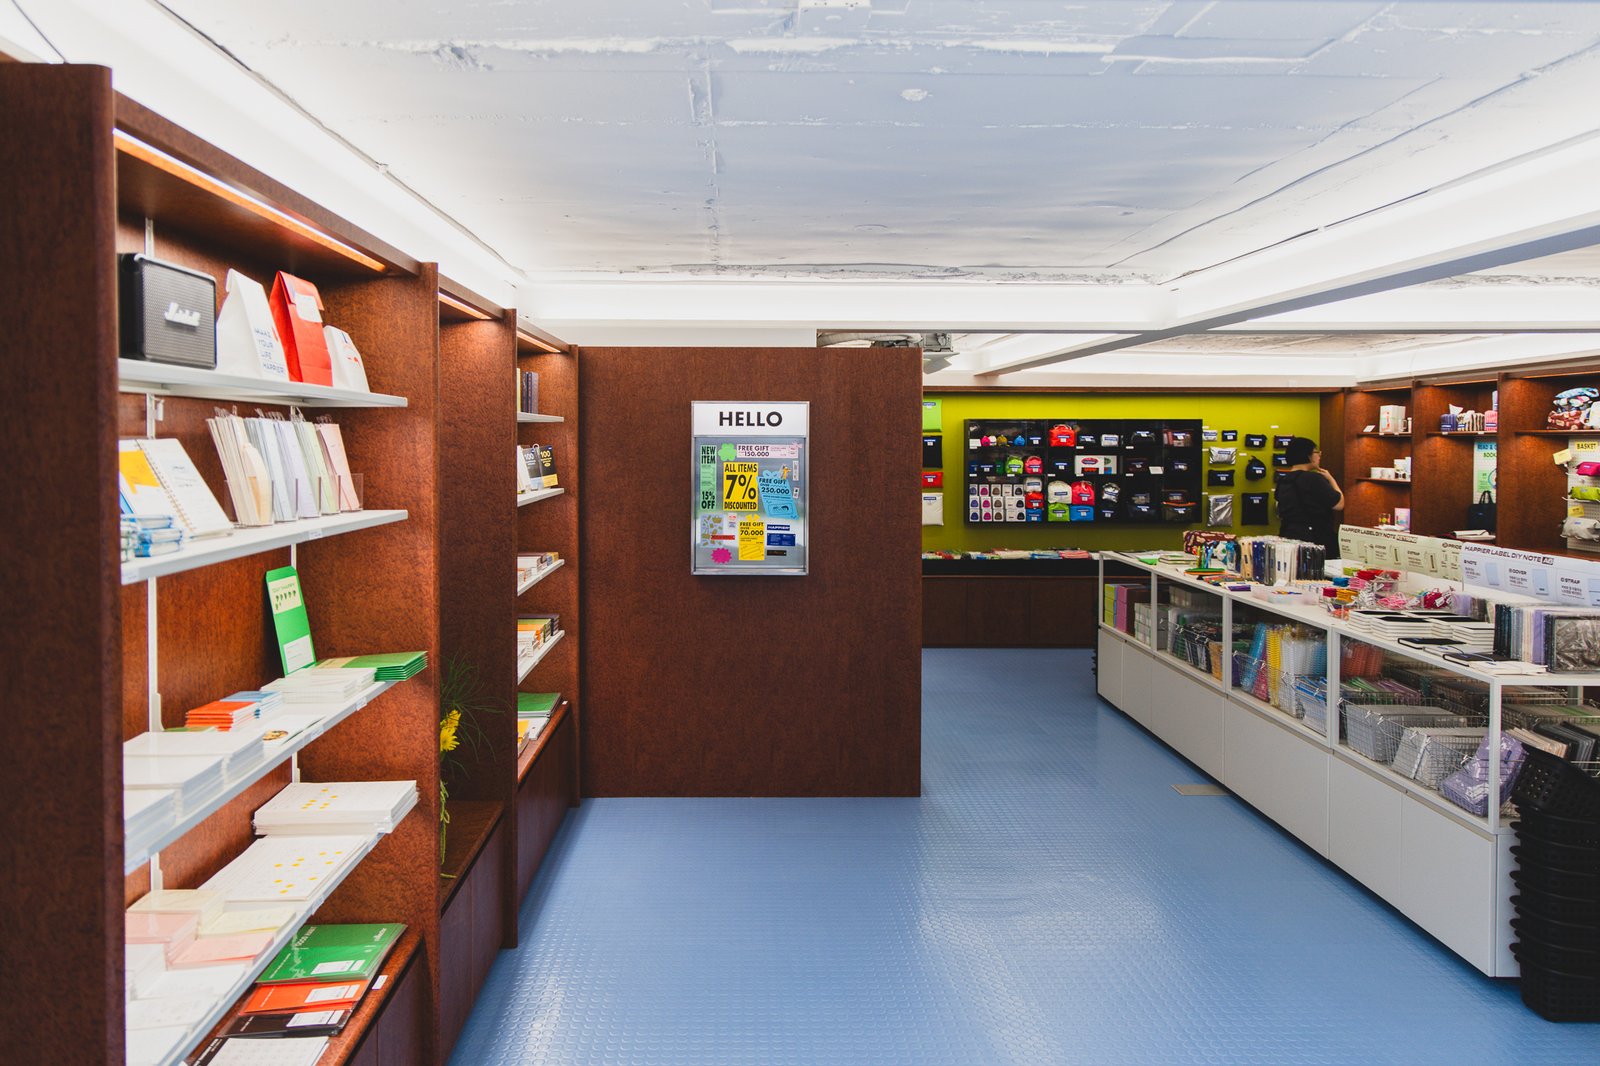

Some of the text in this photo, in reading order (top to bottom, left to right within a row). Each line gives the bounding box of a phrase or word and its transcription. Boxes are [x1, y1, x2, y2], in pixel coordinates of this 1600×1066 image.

[718, 411, 783, 427] HELLO
[540, 450, 551, 458] 100
[701, 446, 716, 455] NEW
[701, 456, 716, 464] ITEM
[725, 464, 757, 472] ALL ITEMS
[725, 474, 757, 500] 7%
[702, 491, 715, 500] 15%
[701, 501, 715, 510] OFF
[724, 502, 757, 510] DISCOUNTED
[1464, 546, 1490, 554] HAPPIER
[1491, 549, 1510, 558] LABEL
[1523, 555, 1541, 563] NOTE
